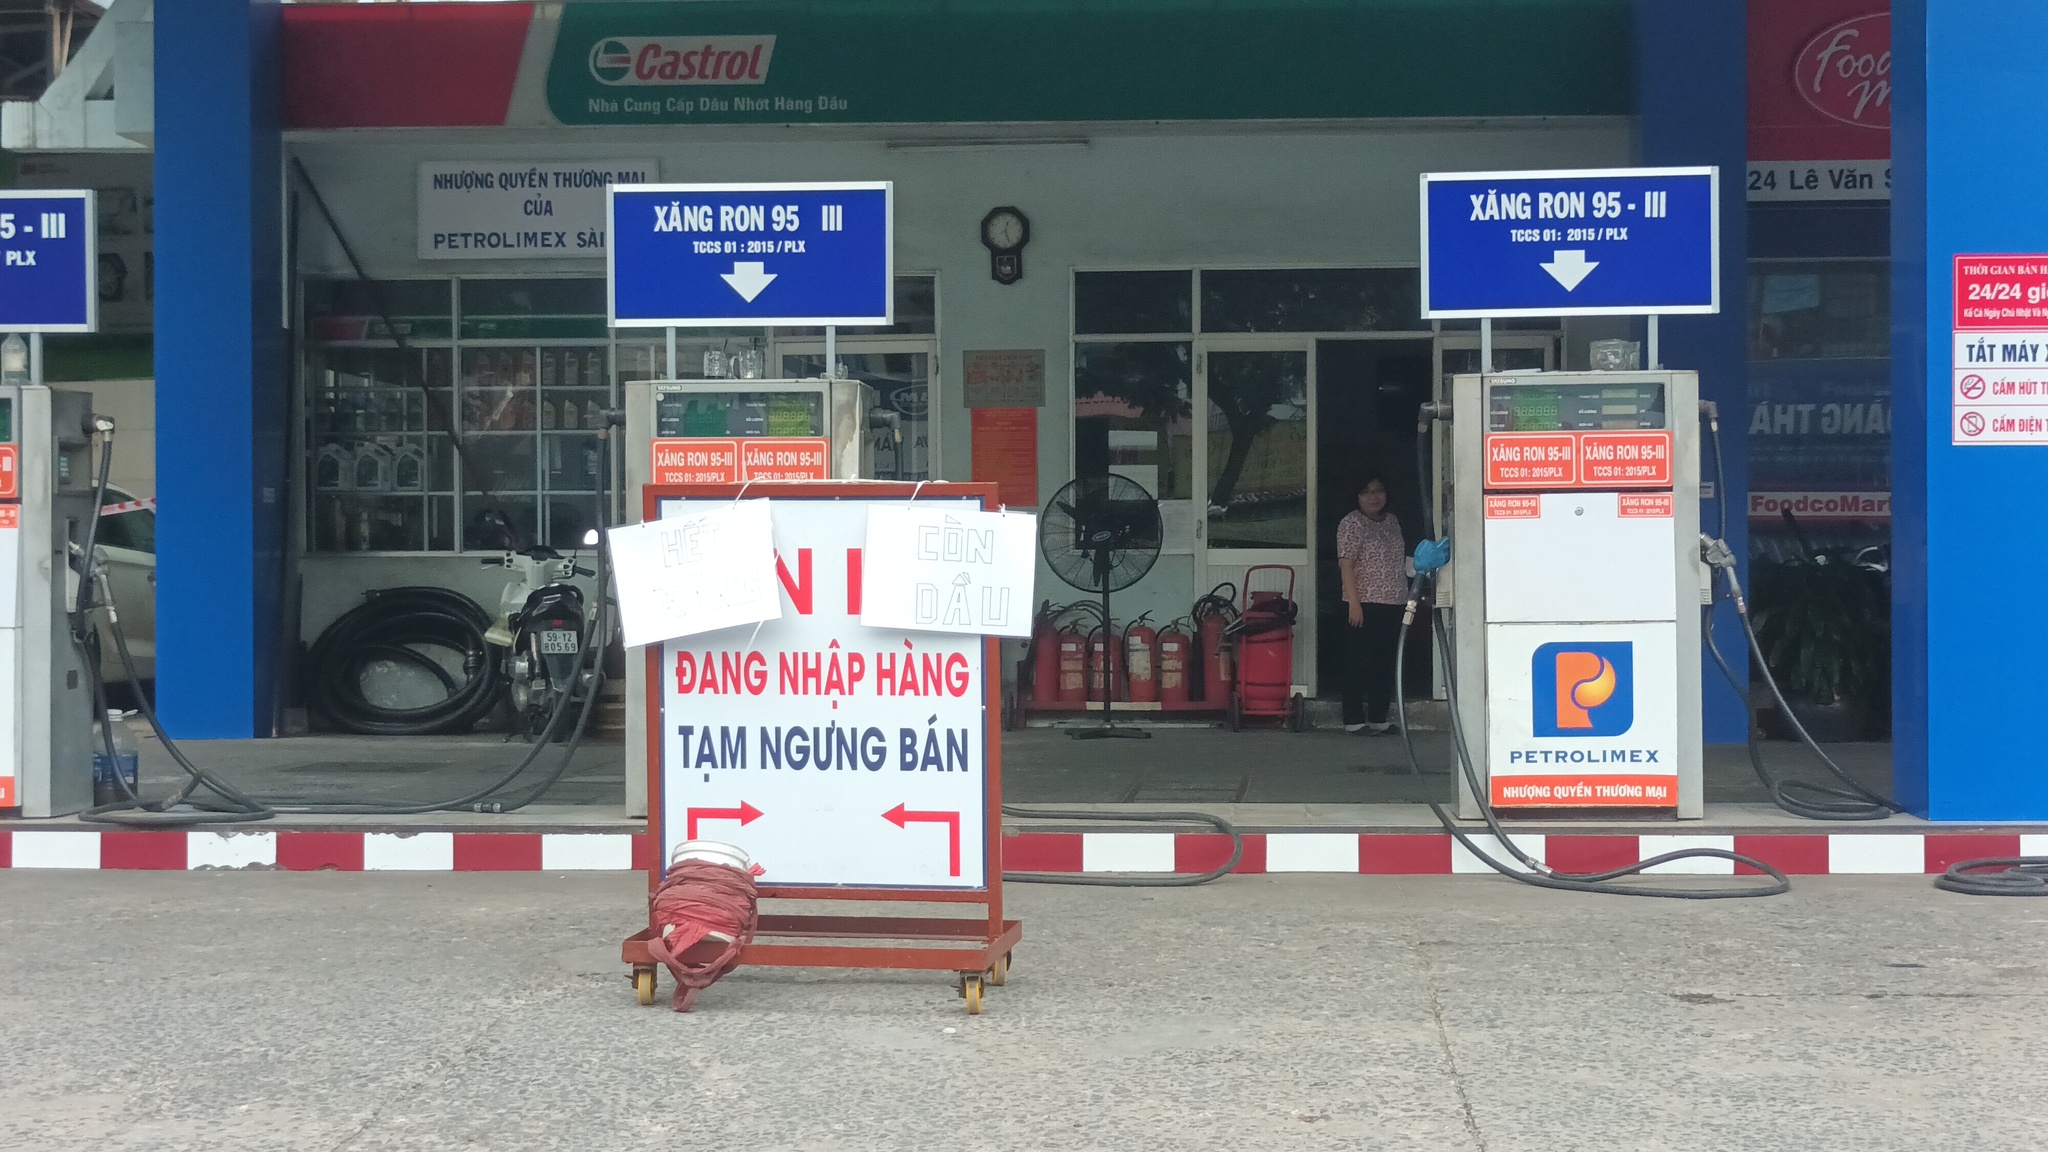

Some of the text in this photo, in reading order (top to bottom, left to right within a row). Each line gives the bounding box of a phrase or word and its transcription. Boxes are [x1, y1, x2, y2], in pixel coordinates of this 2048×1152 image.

[635, 44, 763, 80] Castrol
[588, 98, 618, 113] Nhà
[624, 97, 660, 115] Cung
[774, 95, 812, 114] Hàng
[433, 169, 494, 193] NHƯỢNG
[553, 168, 613, 189] THƯƠNG
[1789, 169, 1819, 190] Lê
[1828, 168, 1873, 190] Văn
[523, 192, 554, 217] CỦA
[1470, 188, 1532, 221] XĂNG
[1538, 191, 1585, 219] RON
[1592, 191, 1622, 219] 95
[1644, 190, 1667, 218] III
[41, 212, 66, 239] III
[654, 200, 843, 232] XĂNG RON 95 III
[433, 227, 605, 250] PETROLIMEX SÀI
[1510, 228, 1541, 243] TCCS
[1567, 228, 1595, 242] 2015
[1605, 227, 1629, 241] PLX
[693, 240, 722, 254] TCCS
[747, 240, 775, 253] 2015
[784, 240, 806, 253] PLX
[6, 250, 37, 266] PLX
[1990, 264, 2015, 275] GIAN
[2017, 262, 2038, 275] BÁN
[1968, 282, 2048, 304] 24/24 gi
[1966, 337, 1996, 362] TẮT
[2002, 340, 2039, 362] MÁY
[1992, 377, 2015, 395] CẤM
[2018, 378, 2038, 395] HÚT
[1992, 413, 2015, 432] CẤM
[2018, 416, 2042, 435] ĐIỆN
[657, 448, 733, 467] XĂNG RON 95-III
[746, 447, 822, 466] XĂNG RON 95-III
[1492, 443, 1571, 462] XĂNG RON 95-III
[1585, 442, 1665, 460] XĂNG RON 95-III
[664, 472, 683, 482] TCCS
[695, 471, 725, 482] 2015/PLX
[1499, 467, 1519, 478] TCCS
[1532, 467, 1563, 478] 2015/PLX
[1593, 466, 1612, 477] TCCS
[1625, 465, 1657, 477] 2015/PLX
[918, 514, 994, 565] CÒN
[916, 571, 1010, 627] DẦU
[676, 637, 970, 710] ĐANG NHẬP HÀNG
[678, 713, 968, 783] TẠM NGƯNG BÁN
[1510, 749, 1659, 764] PETROLIMEX
[1503, 782, 1551, 801] NHƯỢNG
[1595, 782, 1643, 799] THƯƠNG
[1645, 785, 1667, 801] MẠI
